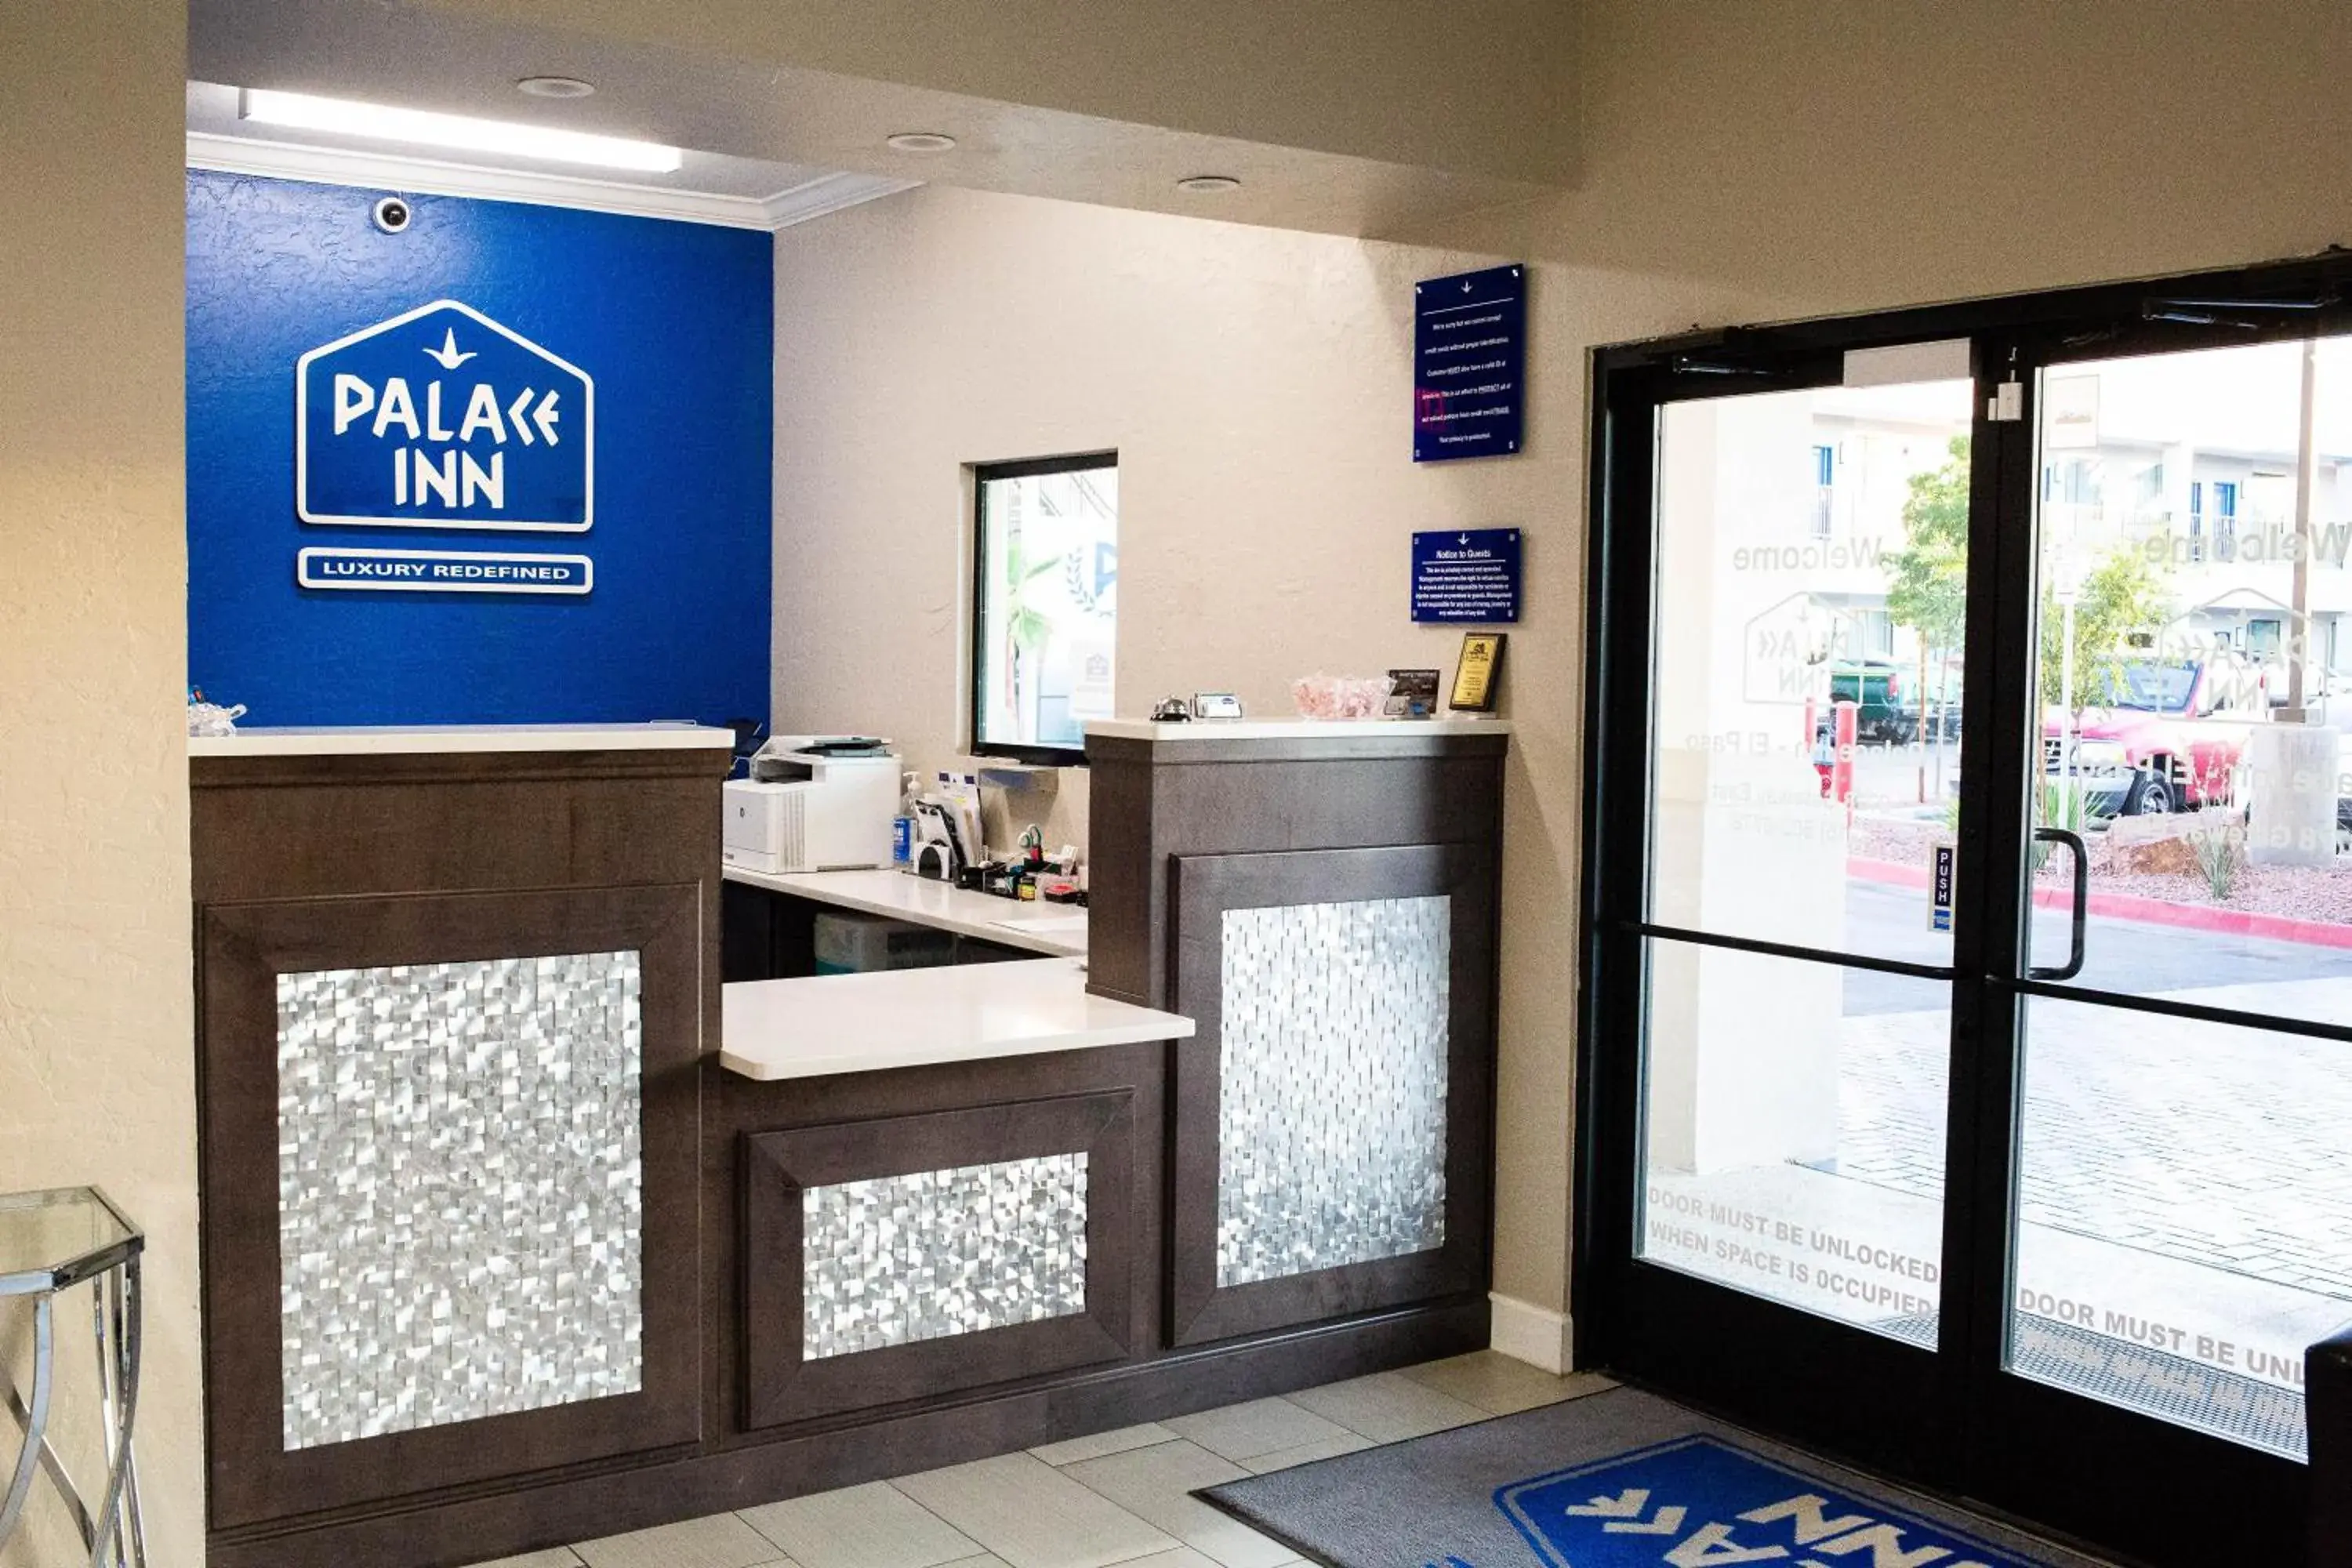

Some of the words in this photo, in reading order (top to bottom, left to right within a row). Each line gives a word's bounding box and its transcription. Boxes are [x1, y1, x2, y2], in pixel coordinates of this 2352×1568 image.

[334, 374, 560, 446] PALACE
[394, 448, 503, 509] INN
[322, 562, 426, 577] LUXURY
[434, 564, 570, 580] REDEFINED
[1436, 549, 1457, 559] Notice
[1458, 549, 1466, 558] to
[1467, 548, 1491, 558] Guests
[1938, 852, 1948, 902] PUSH
[1649, 1185, 1704, 1218] DOOR
[1711, 1203, 1769, 1234] MUST
[1776, 1221, 1802, 1246] BE
[1810, 1231, 1938, 1283] UNLOCKED
[1650, 1219, 1708, 1254] WHEN
[1715, 1239, 1781, 1275] SPACE
[1788, 1261, 1809, 1284] IS
[2020, 1288, 2095, 1327] DOOR
[2105, 1310, 2187, 1350] MUST
[2196, 1335, 2235, 1366] BE
